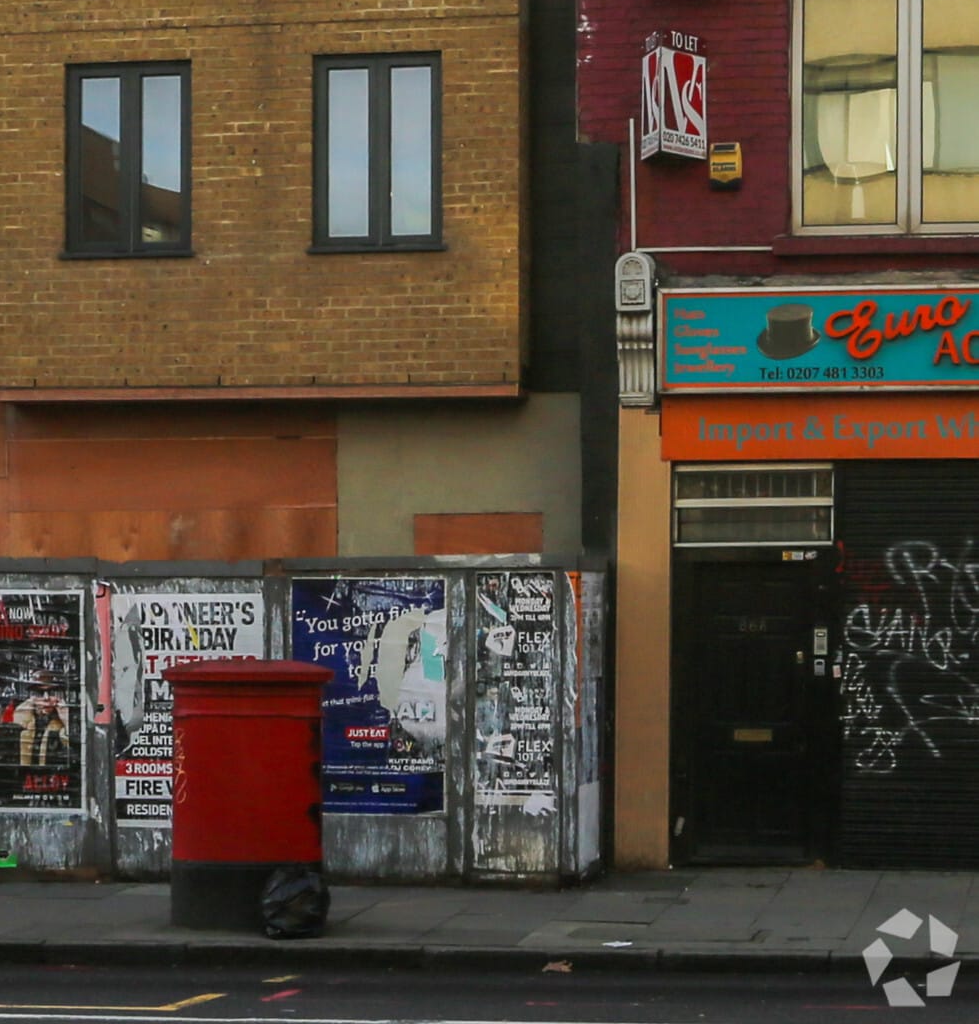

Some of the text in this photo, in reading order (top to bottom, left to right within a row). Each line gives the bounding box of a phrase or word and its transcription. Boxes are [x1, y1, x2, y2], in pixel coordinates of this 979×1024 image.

[671, 30, 683, 49] TO
[685, 35, 698, 52] LET
[825, 295, 971, 360] Euro
[759, 367, 884, 380] Tel: 0207 481 3303
[698, 415, 795, 451] Import
[802, 415, 824, 441] &
[832, 414, 927, 450] Export
[342, 610, 386, 633] gotta
[518, 631, 551, 643] FLEX
[313, 641, 338, 661] for
[348, 728, 387, 738] JUST EAT
[518, 740, 551, 753] FLEX
[125, 763, 173, 775] 3 ROOMS
[126, 779, 163, 796] FIRE
